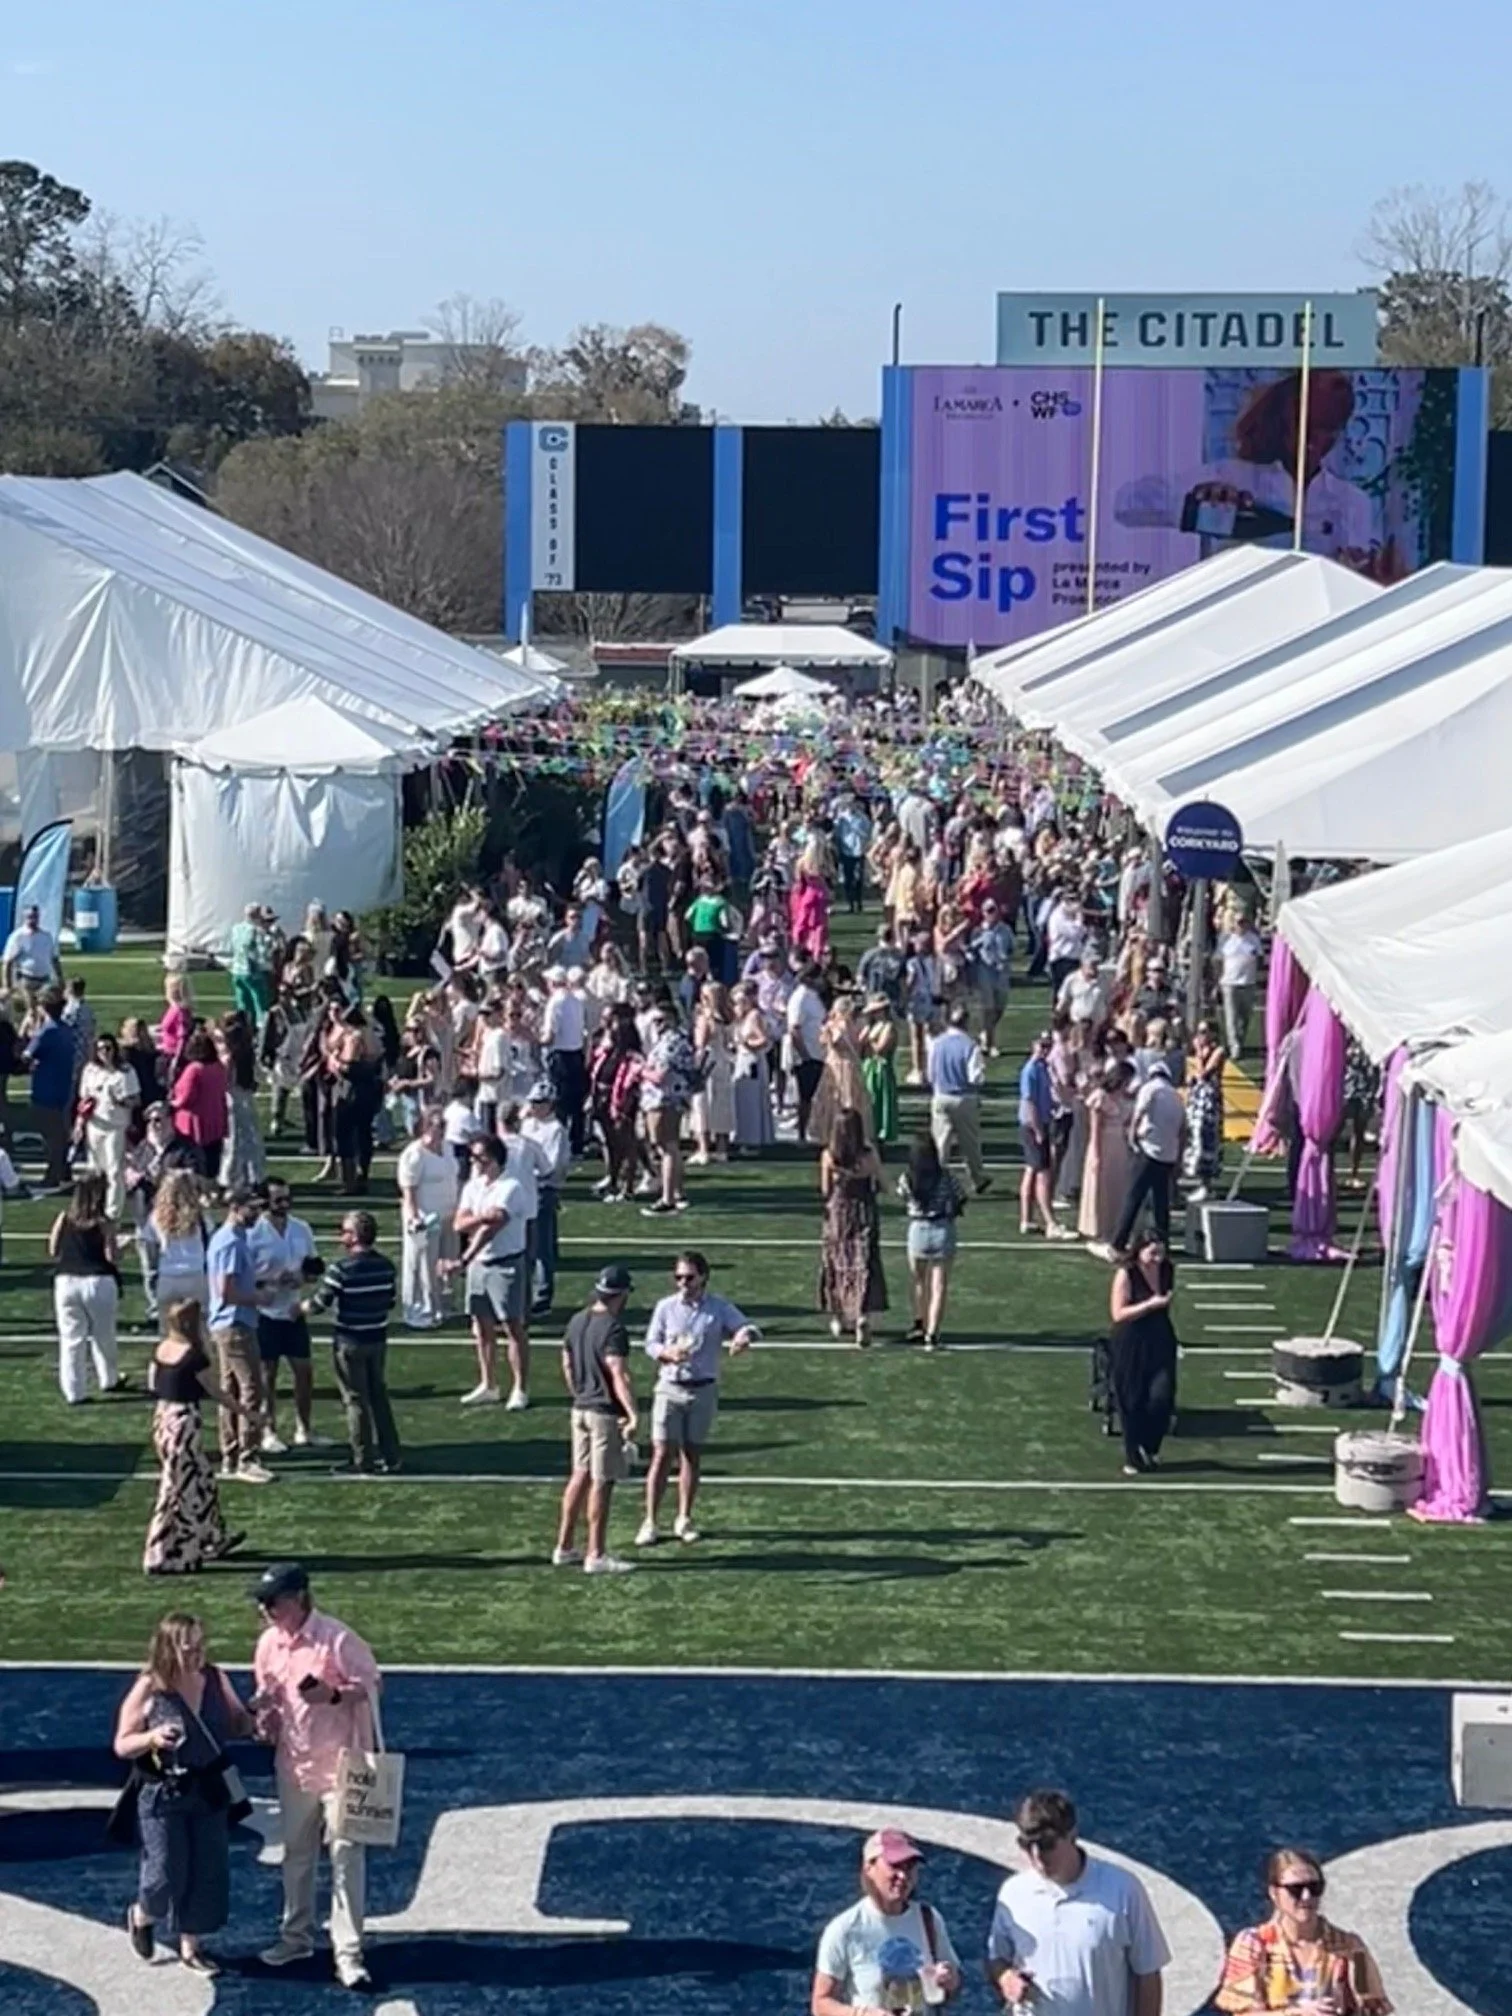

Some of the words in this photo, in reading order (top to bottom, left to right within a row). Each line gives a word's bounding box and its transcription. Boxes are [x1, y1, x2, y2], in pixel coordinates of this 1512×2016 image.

[1028, 311, 1120, 348] THE
[1138, 311, 1345, 348] CITADEL
[549, 457, 558, 530] CLASS
[934, 492, 1086, 543] First
[929, 552, 1037, 613] Sip
[1053, 562, 1129, 575] presnted
[1132, 562, 1151, 575] by
[1053, 578, 1070, 589] La
[1075, 577, 1121, 589] Mrca
